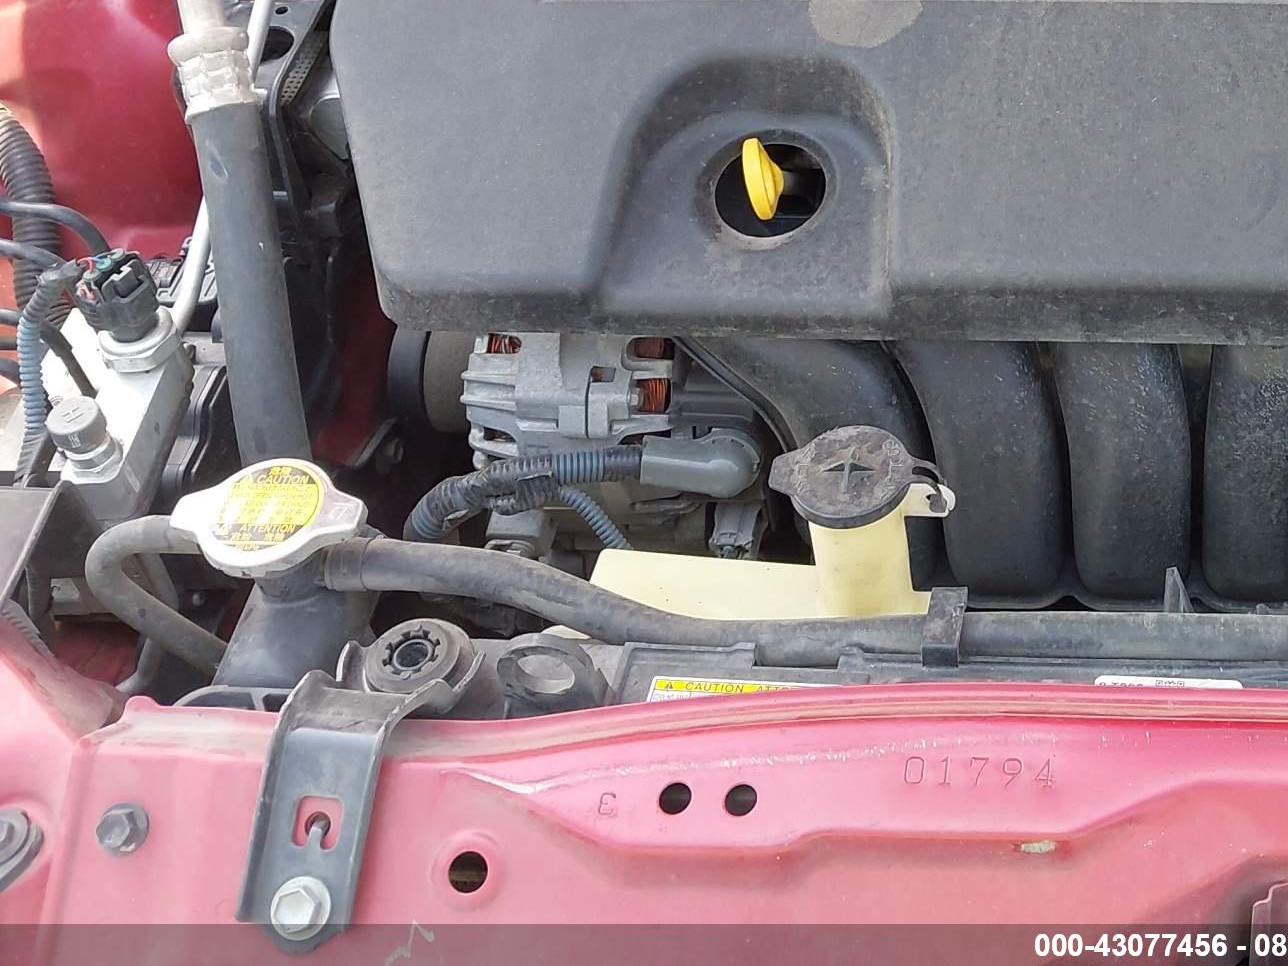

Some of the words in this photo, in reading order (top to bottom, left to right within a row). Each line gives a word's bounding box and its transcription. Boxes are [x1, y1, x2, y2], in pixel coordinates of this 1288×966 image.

[256, 474, 310, 484] CAUTION
[238, 524, 296, 534] ATTENTION
[684, 682, 745, 693] CAUTION
[903, 755, 1057, 787] 01794
